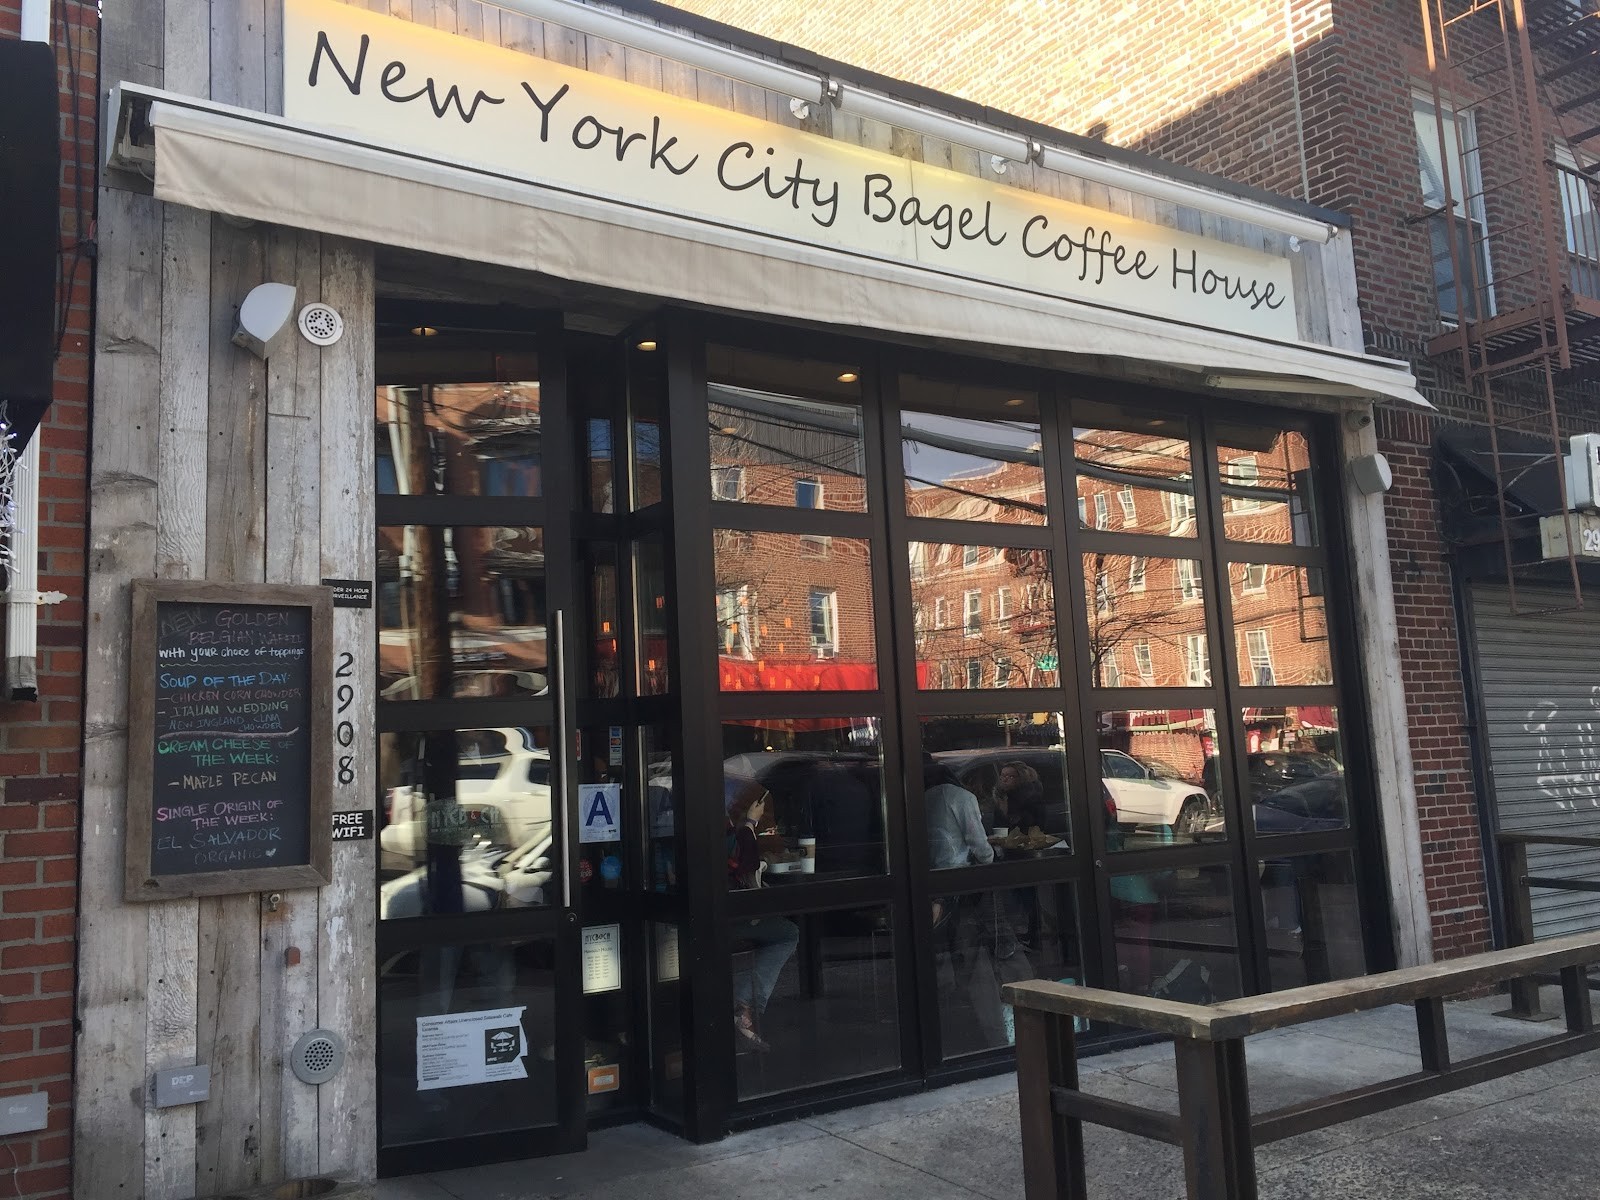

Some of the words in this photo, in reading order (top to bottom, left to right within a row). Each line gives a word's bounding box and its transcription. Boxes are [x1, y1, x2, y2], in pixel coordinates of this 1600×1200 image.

[309, 31, 504, 123] New
[521, 81, 698, 175] York
[717, 141, 838, 226] City
[864, 174, 1006, 249] Bagel
[1023, 215, 1159, 284] Coffee
[1172, 248, 1285, 310] House
[215, 610, 289, 628] GOLDEN
[188, 630, 254, 645] BELGIAN
[159, 647, 185, 658] with
[221, 647, 250, 656] choice
[255, 647, 267, 655] of
[268, 647, 304, 660] toppings
[160, 673, 196, 688] SOUP
[203, 676, 224, 688] OF
[228, 675, 256, 686] THE
[170, 691, 219, 703] CHICKEN
[224, 689, 250, 700] CORN
[255, 688, 301, 699] CHOWDER
[170, 705, 219, 718] ITALIAN
[227, 701, 288, 715] WEDDING
[335, 652, 354, 784] 2908
[239, 722, 282, 732] CHOWDER
[158, 740, 209, 754] CREAM
[212, 738, 271, 750] CHEESE
[278, 741, 294, 749] OF
[191, 754, 225, 767] THE
[183, 775, 223, 790] MAPLE
[232, 771, 276, 787] PECAN
[157, 803, 209, 821] SINGLE
[214, 800, 261, 816] ORIGIN
[267, 800, 283, 809] OF
[585, 791, 614, 826] A
[191, 817, 220, 830] THE
[332, 812, 363, 826] FREE
[157, 836, 182, 849] EL
[190, 827, 281, 849] SALVADOR
[332, 826, 364, 839] WIFI
[195, 849, 262, 865] ORGANIC
